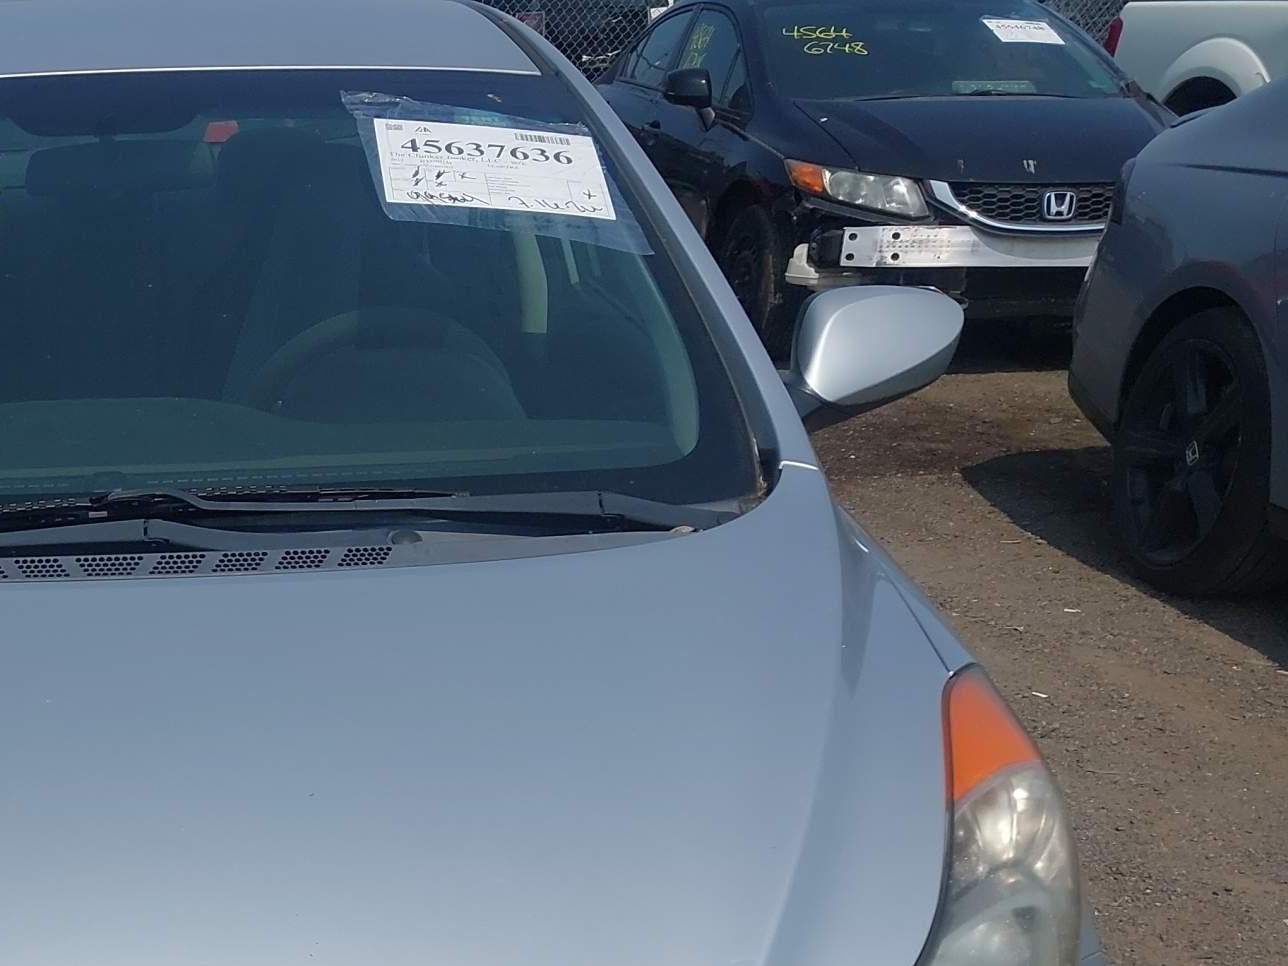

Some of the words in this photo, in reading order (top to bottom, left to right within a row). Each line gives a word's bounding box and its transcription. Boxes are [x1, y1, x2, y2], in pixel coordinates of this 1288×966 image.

[782, 25, 853, 39] 4564
[803, 41, 869, 55] 6748
[400, 138, 573, 165] 45637636
